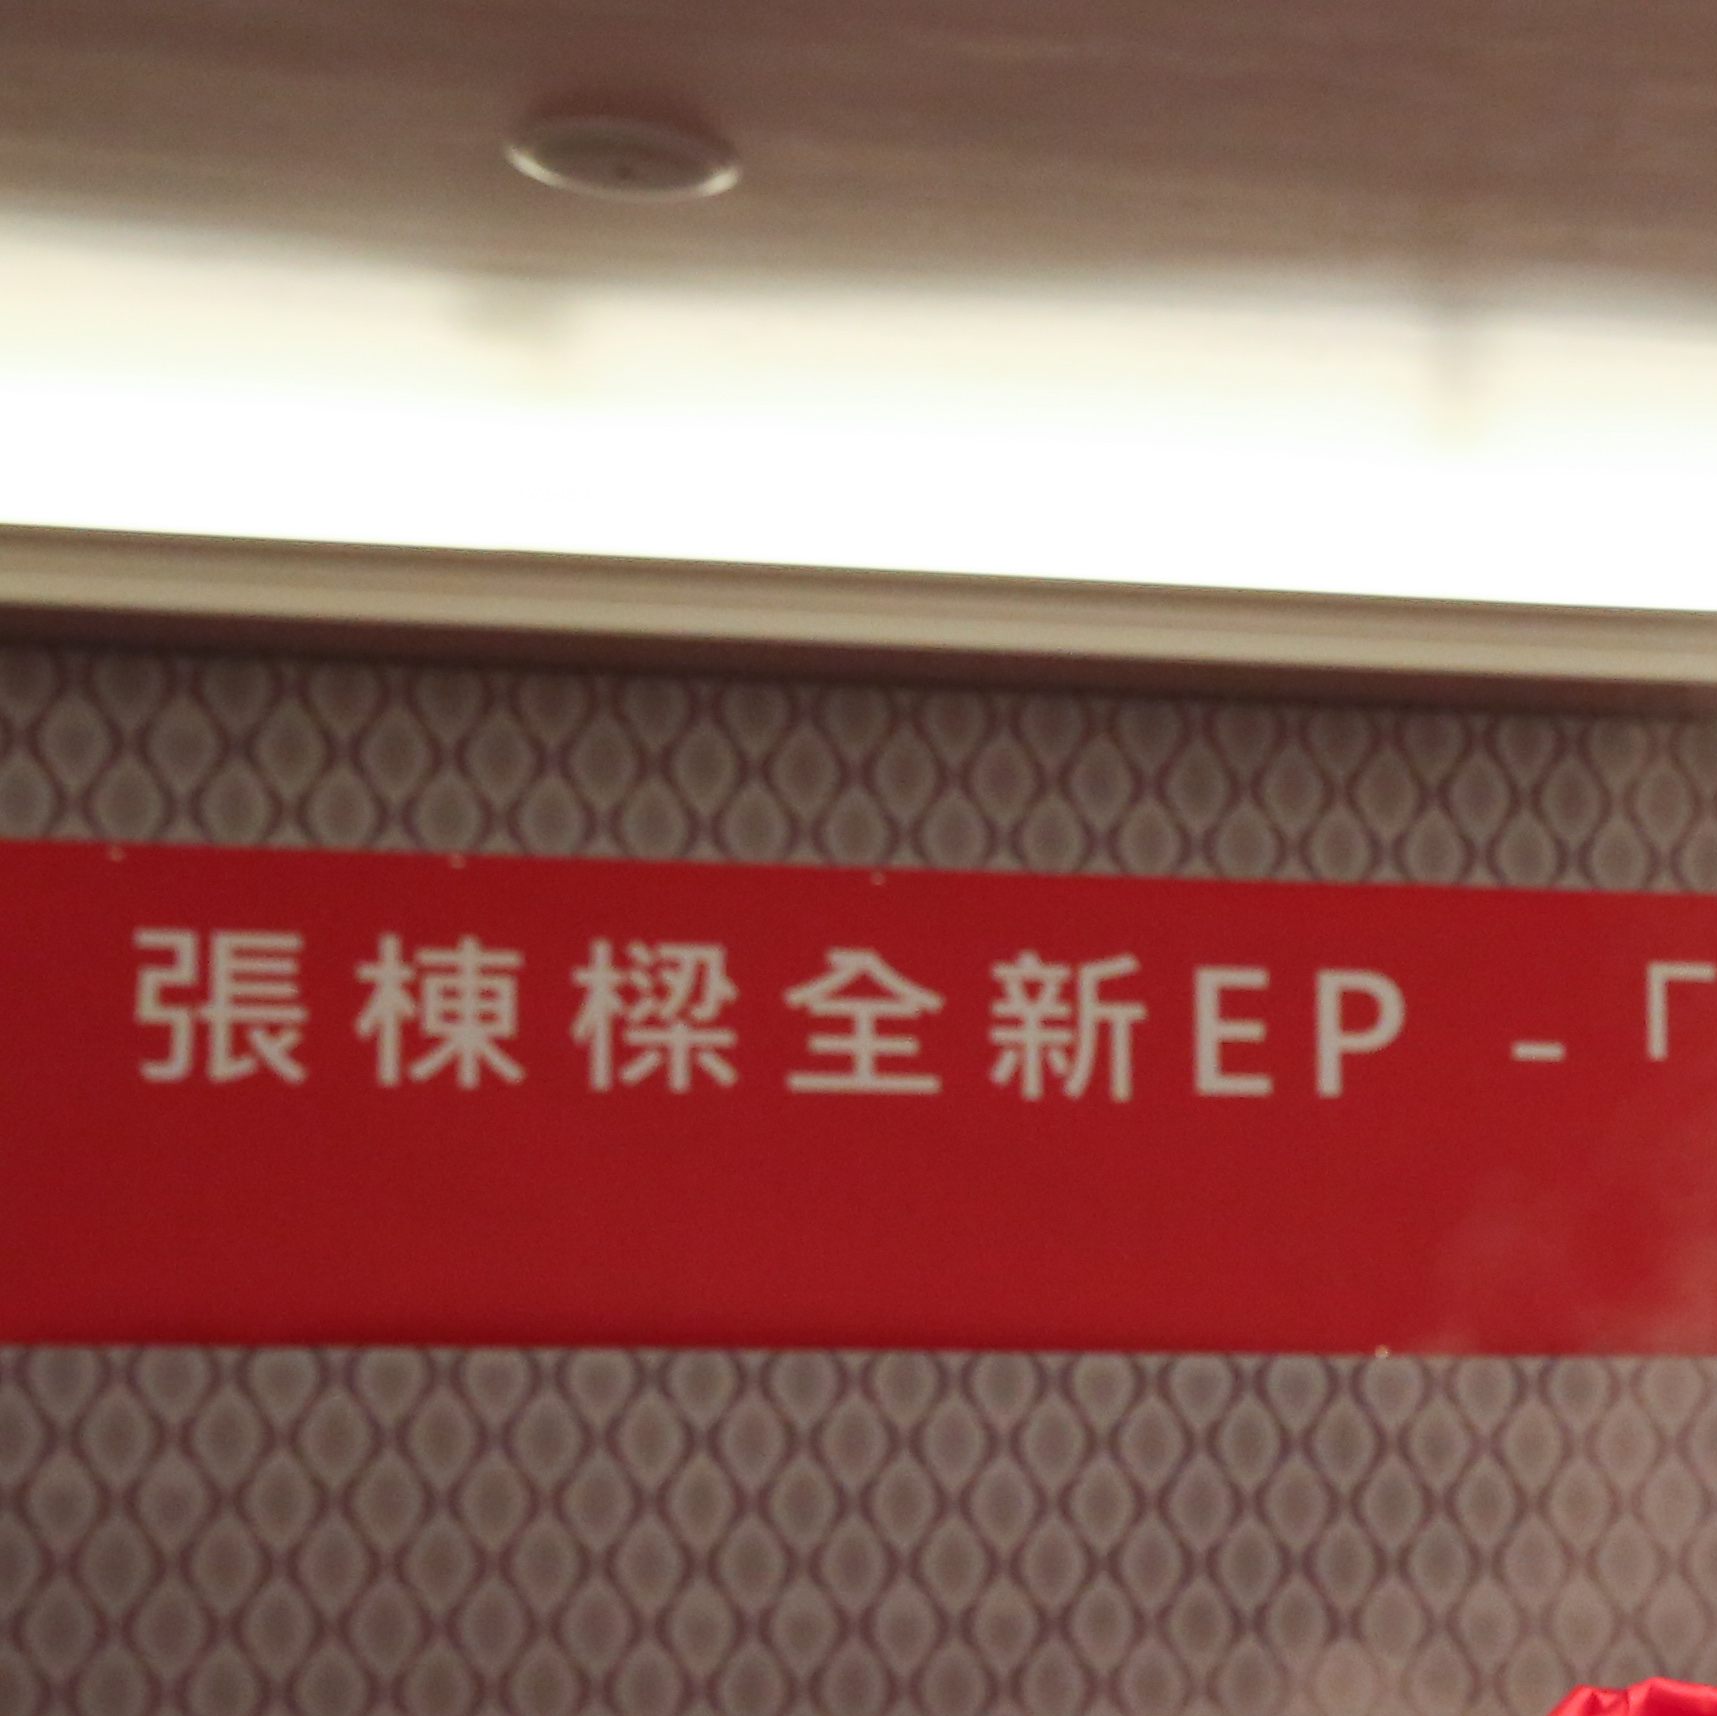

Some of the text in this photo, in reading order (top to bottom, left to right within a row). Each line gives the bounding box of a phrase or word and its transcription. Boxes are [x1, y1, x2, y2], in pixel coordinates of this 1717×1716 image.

[136, 930, 1406, 1102] 張棟樑全新EP
